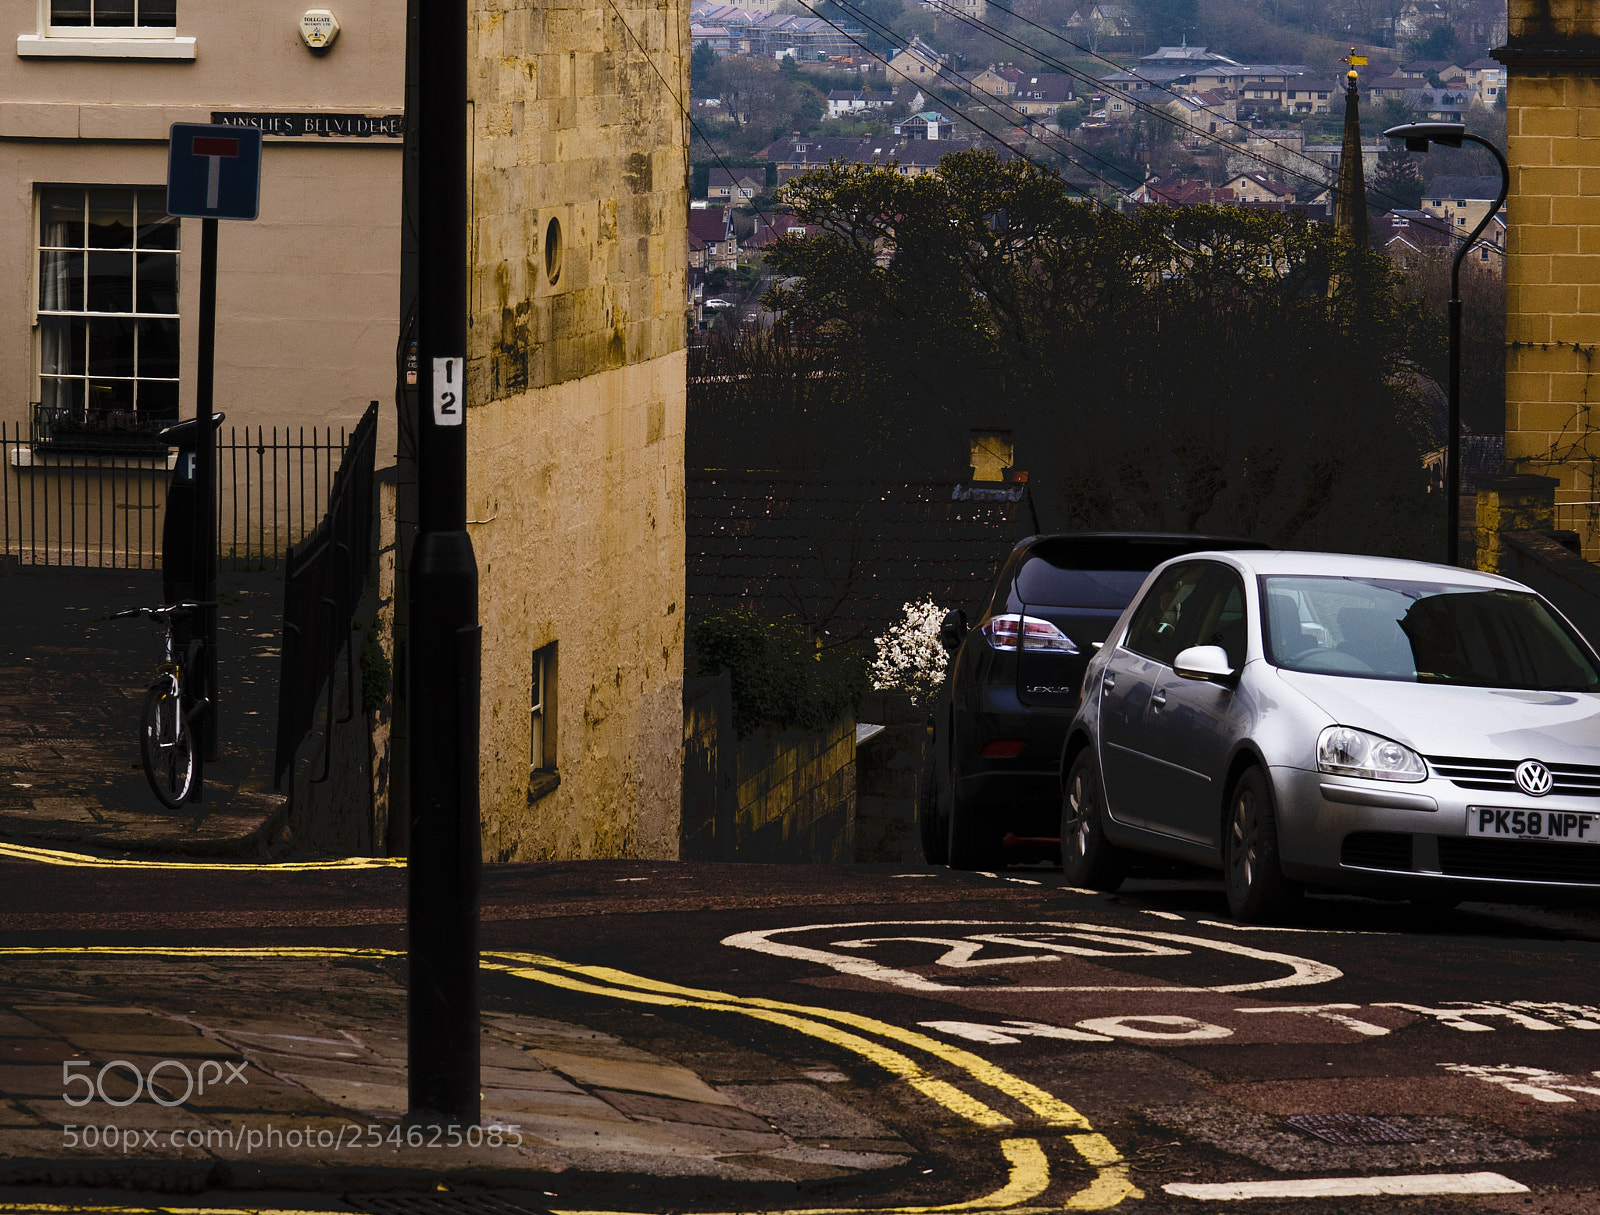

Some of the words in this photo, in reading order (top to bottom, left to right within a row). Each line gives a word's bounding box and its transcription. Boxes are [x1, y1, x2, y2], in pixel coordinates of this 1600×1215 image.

[222, 117, 293, 132] AINSLIES
[1026, 685, 1070, 694] LEXUS
[1479, 809, 1542, 835] PK58
[1547, 813, 1592, 838] NPF
[829, 932, 1192, 968] 20
